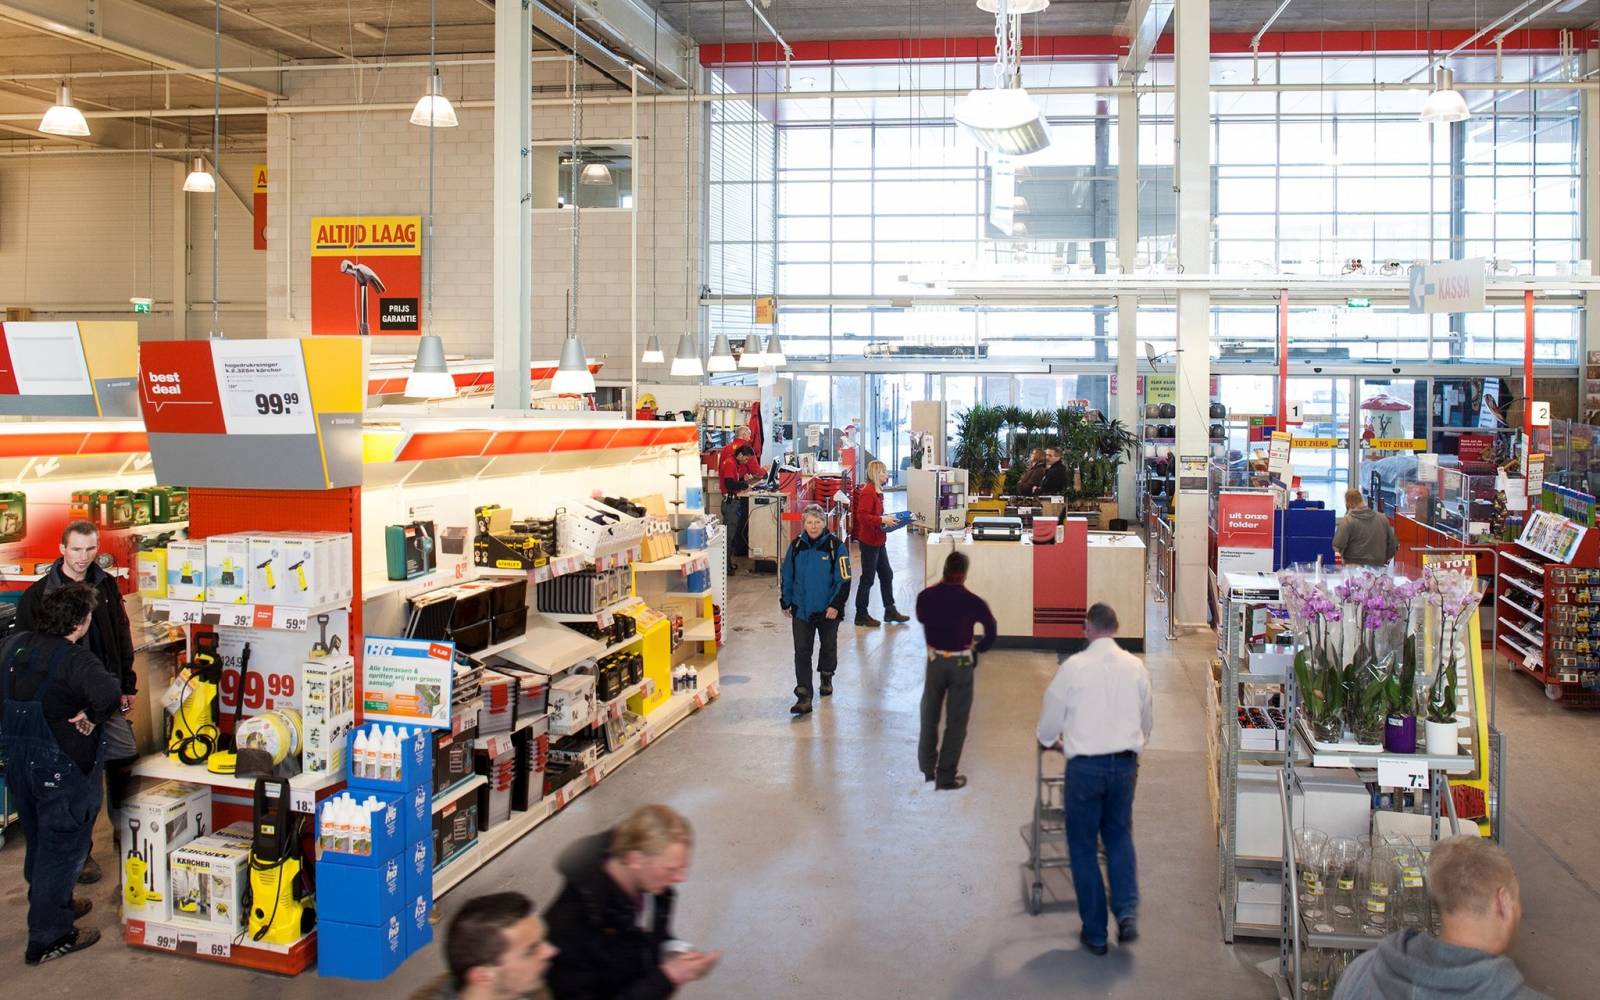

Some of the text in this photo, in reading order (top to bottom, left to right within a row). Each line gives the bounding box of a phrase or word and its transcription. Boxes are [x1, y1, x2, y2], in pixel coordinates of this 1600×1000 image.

[316, 223, 416, 249] ALTIJD LAAG
[1439, 274, 1470, 300] KASSA
[389, 304, 410, 313] PRIJS
[382, 315, 417, 323] GARANTIE
[149, 371, 181, 383] best
[152, 383, 182, 395] deal
[1292, 405, 1299, 417] 1
[1539, 407, 1548, 419] 2
[1295, 440, 1329, 448] TOT ZIENS
[1379, 440, 1413, 449] TOT ZIENS
[945, 514, 960, 523] elho
[1228, 512, 1242, 520] uit
[1229, 520, 1259, 529] folder
[1444, 559, 1472, 569] TOT
[221, 654, 243, 667] 124.9
[176, 856, 210, 868] KÄRCHER
